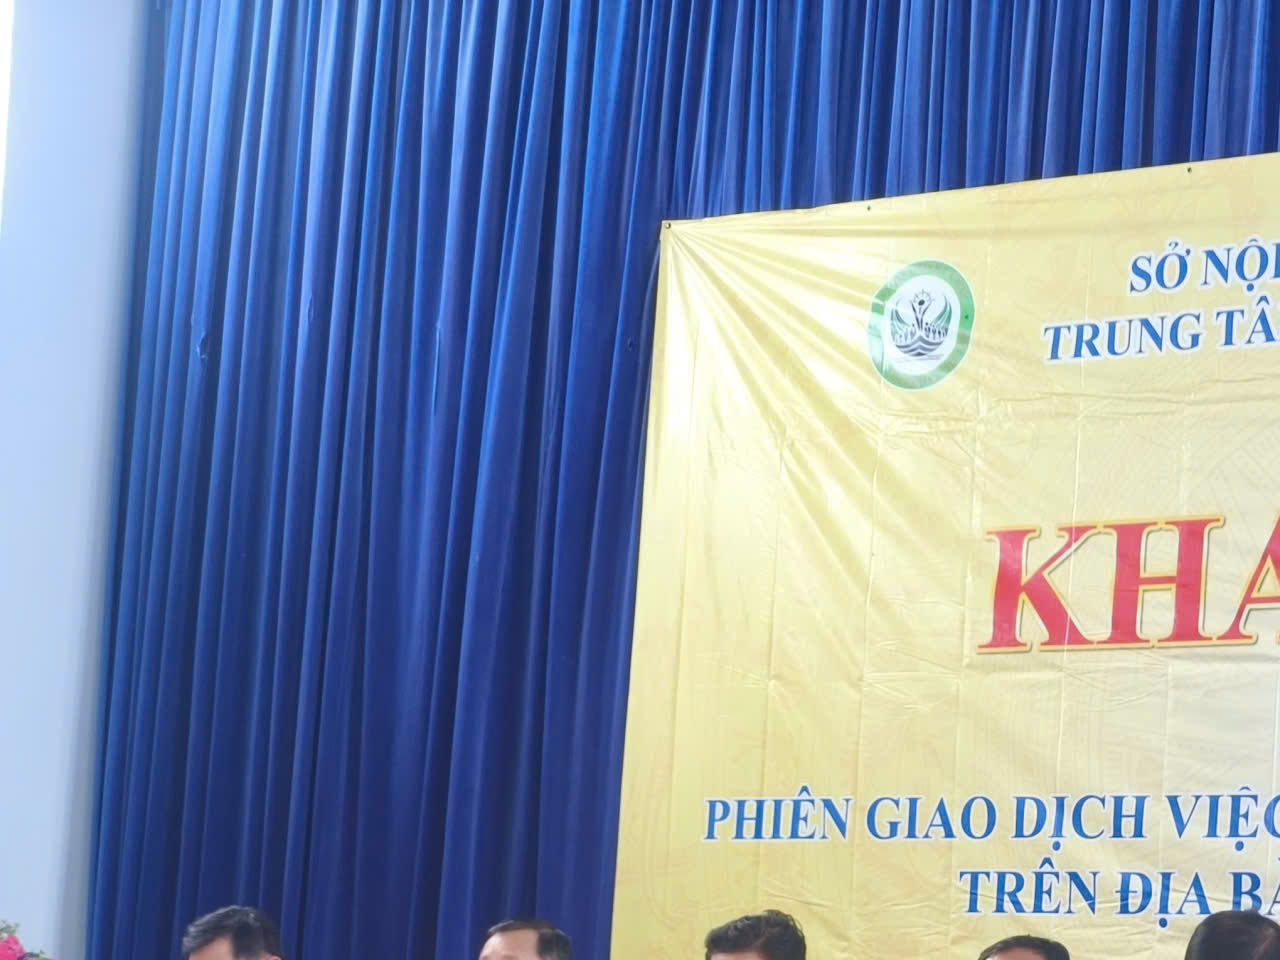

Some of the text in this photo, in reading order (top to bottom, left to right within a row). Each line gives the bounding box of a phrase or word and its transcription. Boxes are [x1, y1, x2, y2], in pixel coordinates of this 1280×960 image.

[1130, 241, 1191, 293] SỞ
[1044, 312, 1202, 361] TRUNG
[704, 785, 853, 840] PHIÊN
[866, 796, 997, 840] GIAO
[1011, 795, 1149, 851] DỊCH
[959, 857, 1100, 914] TRÊN
[1115, 871, 1211, 928] ĐỊA
